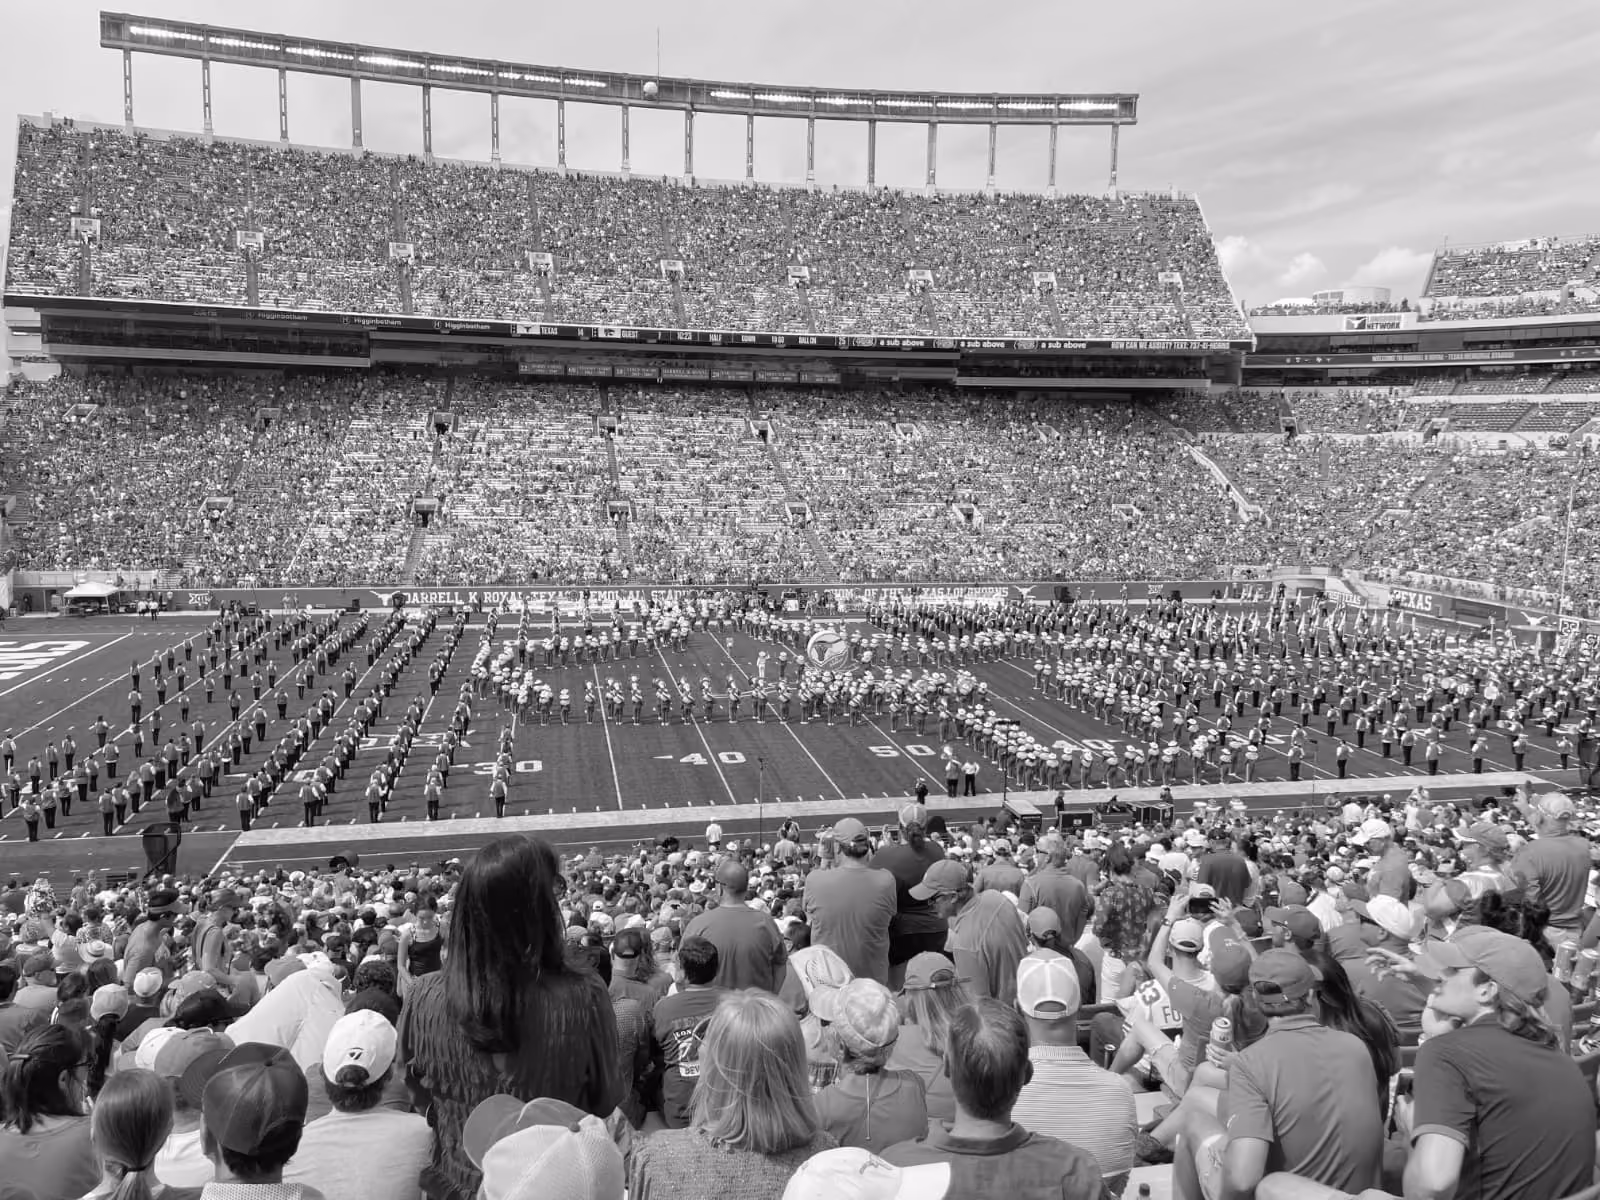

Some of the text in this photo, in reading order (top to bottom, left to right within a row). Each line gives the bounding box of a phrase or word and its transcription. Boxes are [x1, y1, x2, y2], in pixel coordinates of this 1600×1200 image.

[354, 317, 402, 326] Higginbotham
[445, 321, 490, 330] Higginbotham
[540, 326, 558, 335] TEXAS
[404, 592, 464, 605] DARRELL
[469, 592, 478, 603] K
[579, 590, 641, 601] EMOAL
[651, 589, 704, 600] STADIM
[865, 588, 879, 598] OF
[881, 588, 905, 599] THE
[908, 587, 944, 598] XAS
[1393, 590, 1432, 611] TEXAS
[868, 745, 936, 757] 50
[680, 752, 746, 765] 40
